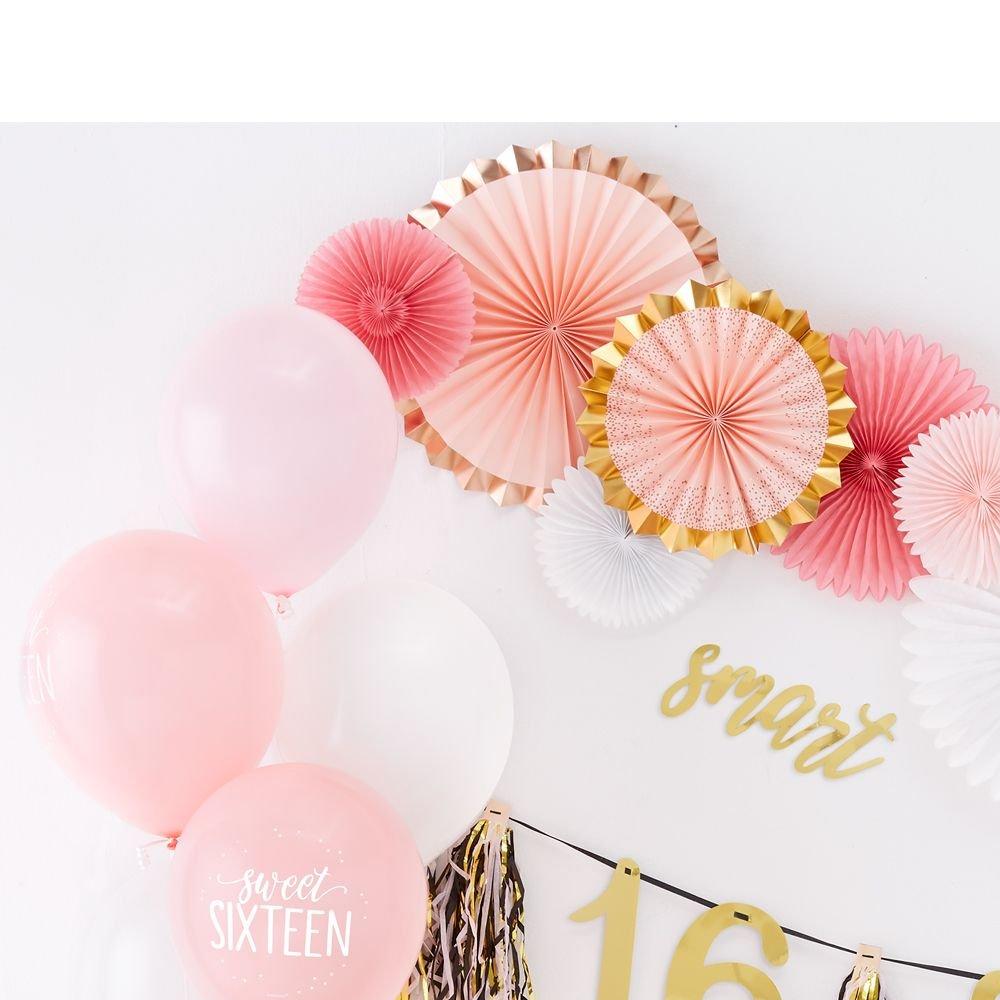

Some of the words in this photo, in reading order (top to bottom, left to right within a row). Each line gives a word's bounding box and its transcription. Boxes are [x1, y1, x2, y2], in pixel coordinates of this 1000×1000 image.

[660, 643, 897, 780] smart
[216, 865, 348, 905] sweet
[208, 899, 353, 958] SIXTEEN
